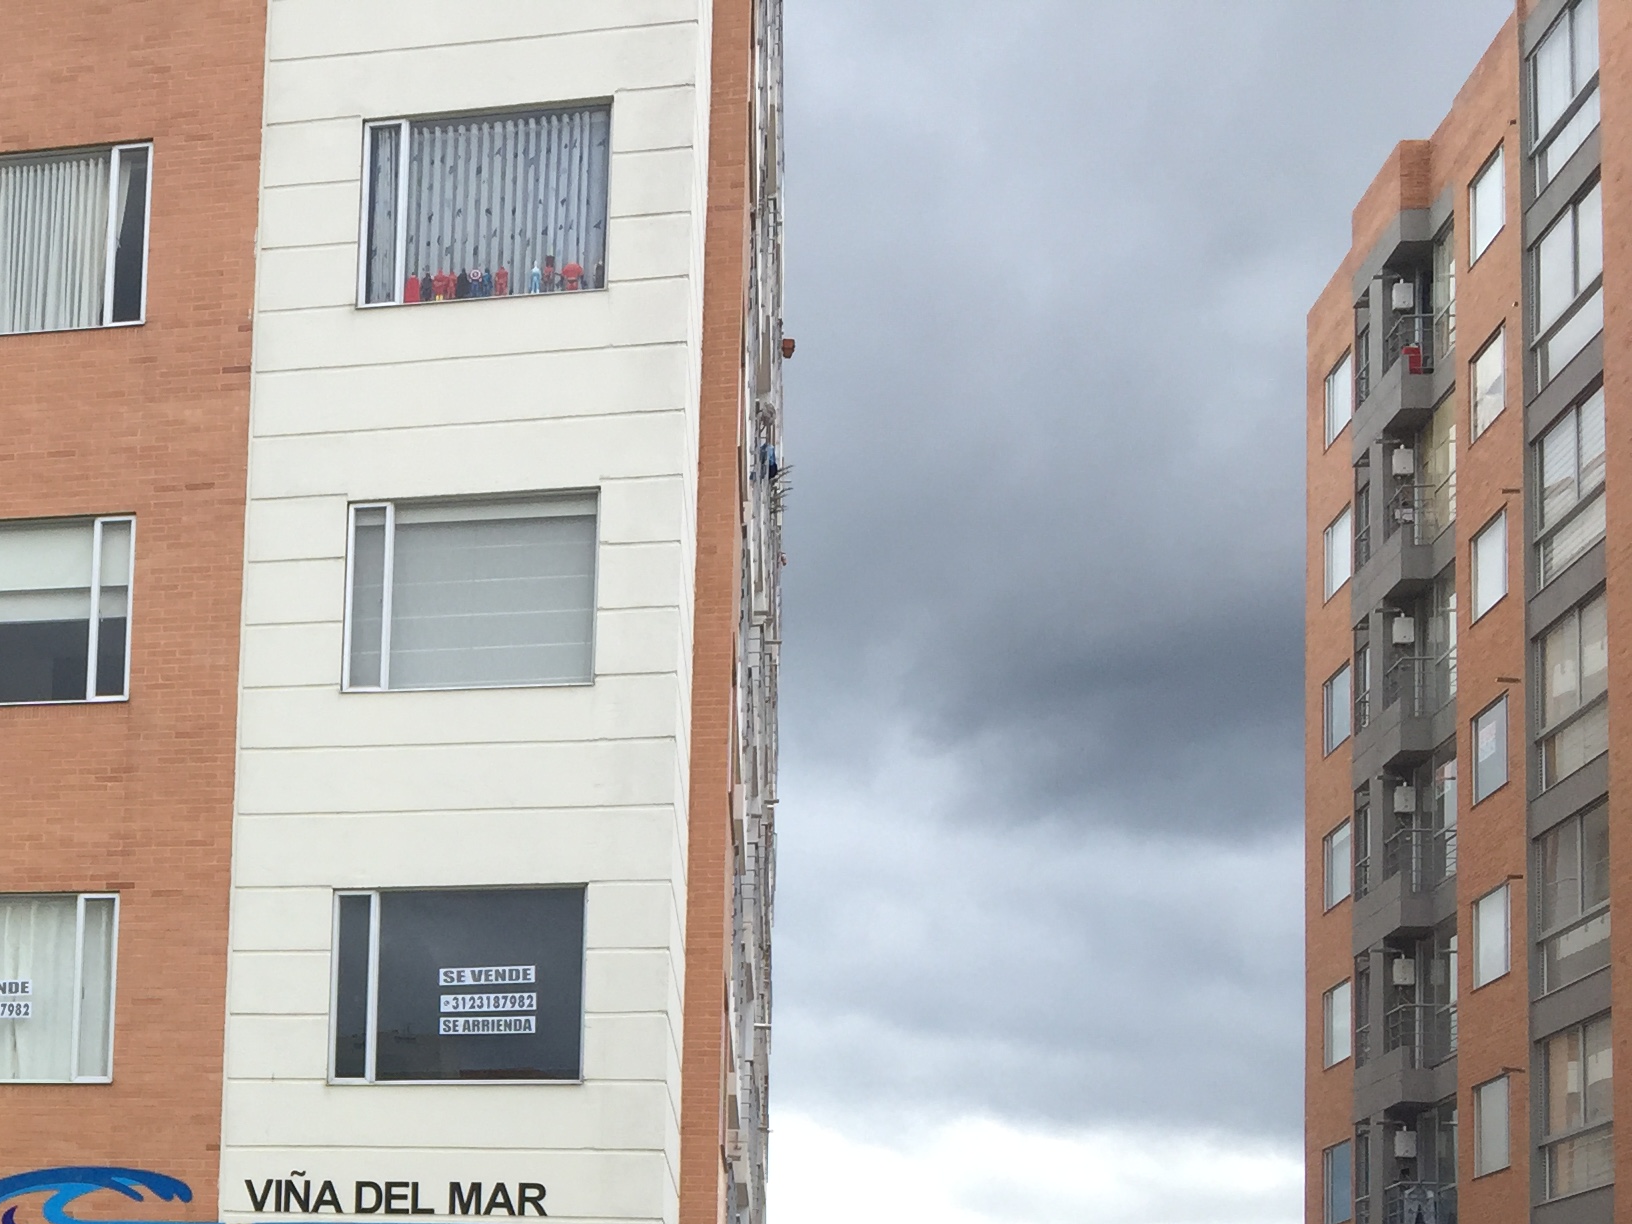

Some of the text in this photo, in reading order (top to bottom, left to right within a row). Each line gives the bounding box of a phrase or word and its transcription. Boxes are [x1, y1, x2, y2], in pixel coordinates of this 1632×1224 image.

[442, 968, 532, 984] SE VENDE
[451, 995, 534, 1010] 3123187982
[442, 1018, 533, 1033] SE ARRIENDA
[244, 1170, 548, 1217] VIÑA DEL MAR
